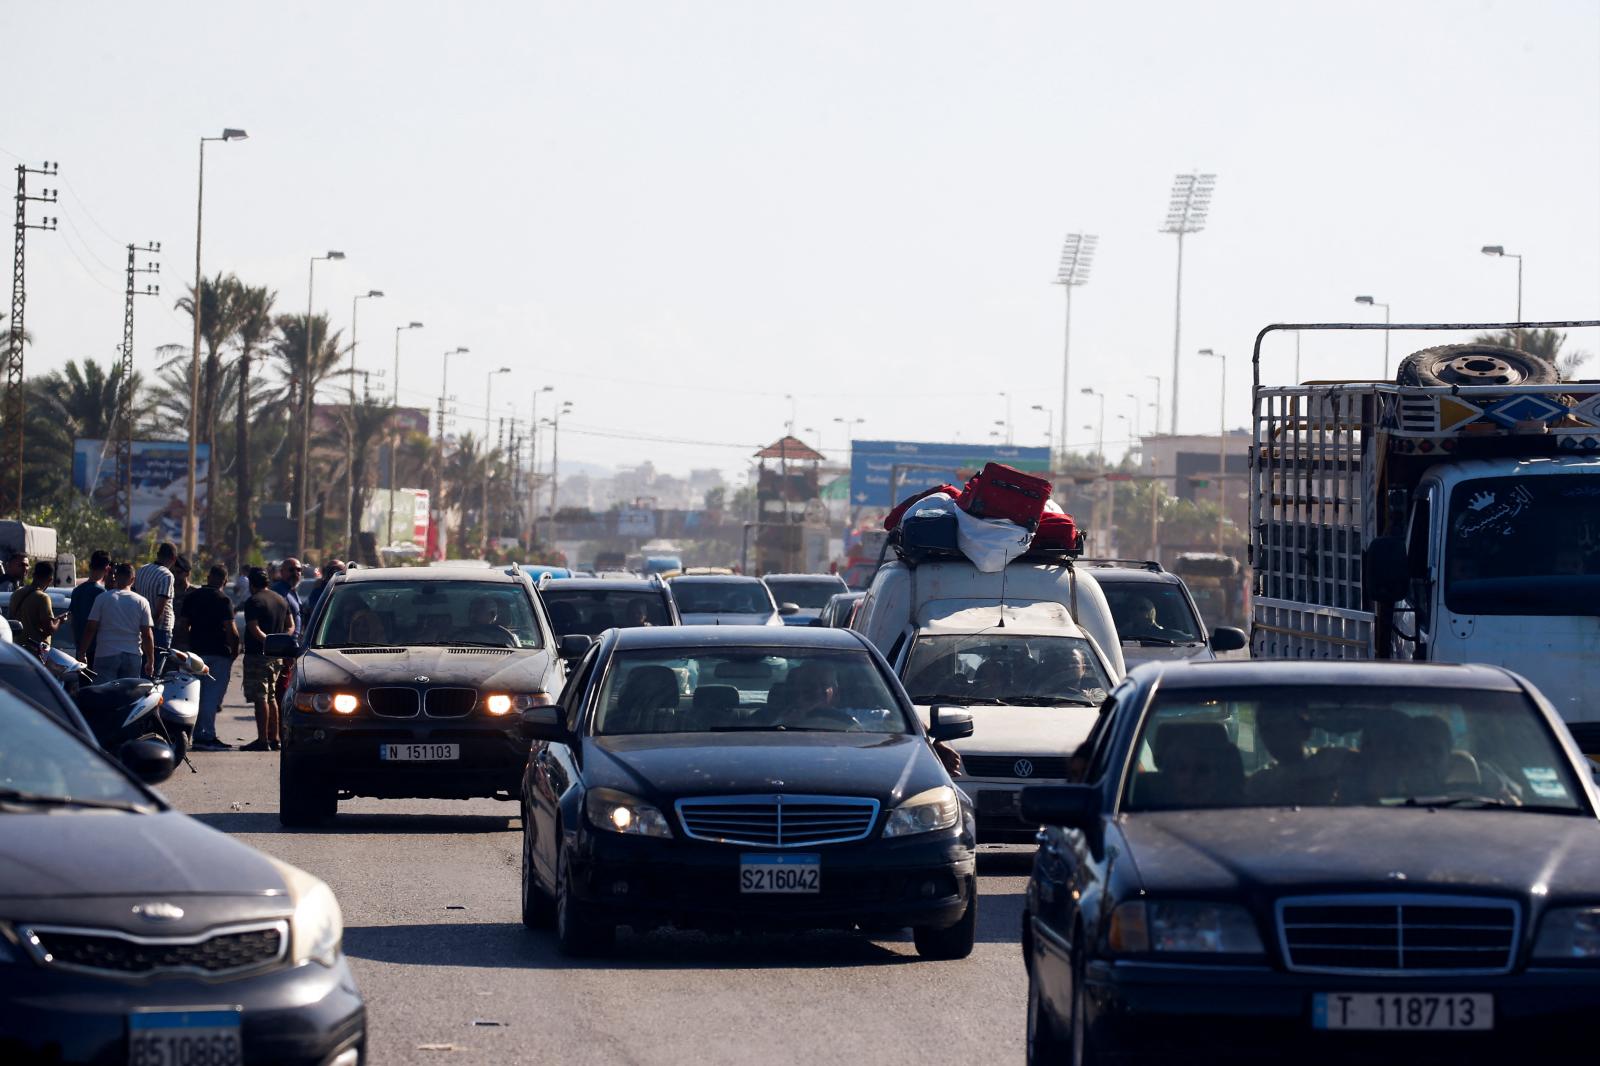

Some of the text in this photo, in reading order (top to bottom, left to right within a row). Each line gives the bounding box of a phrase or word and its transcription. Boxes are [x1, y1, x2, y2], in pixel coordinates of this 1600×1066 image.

[389, 745, 452, 759] N 151103
[742, 869, 818, 889] S216042
[1337, 995, 1475, 1027] T 118713
